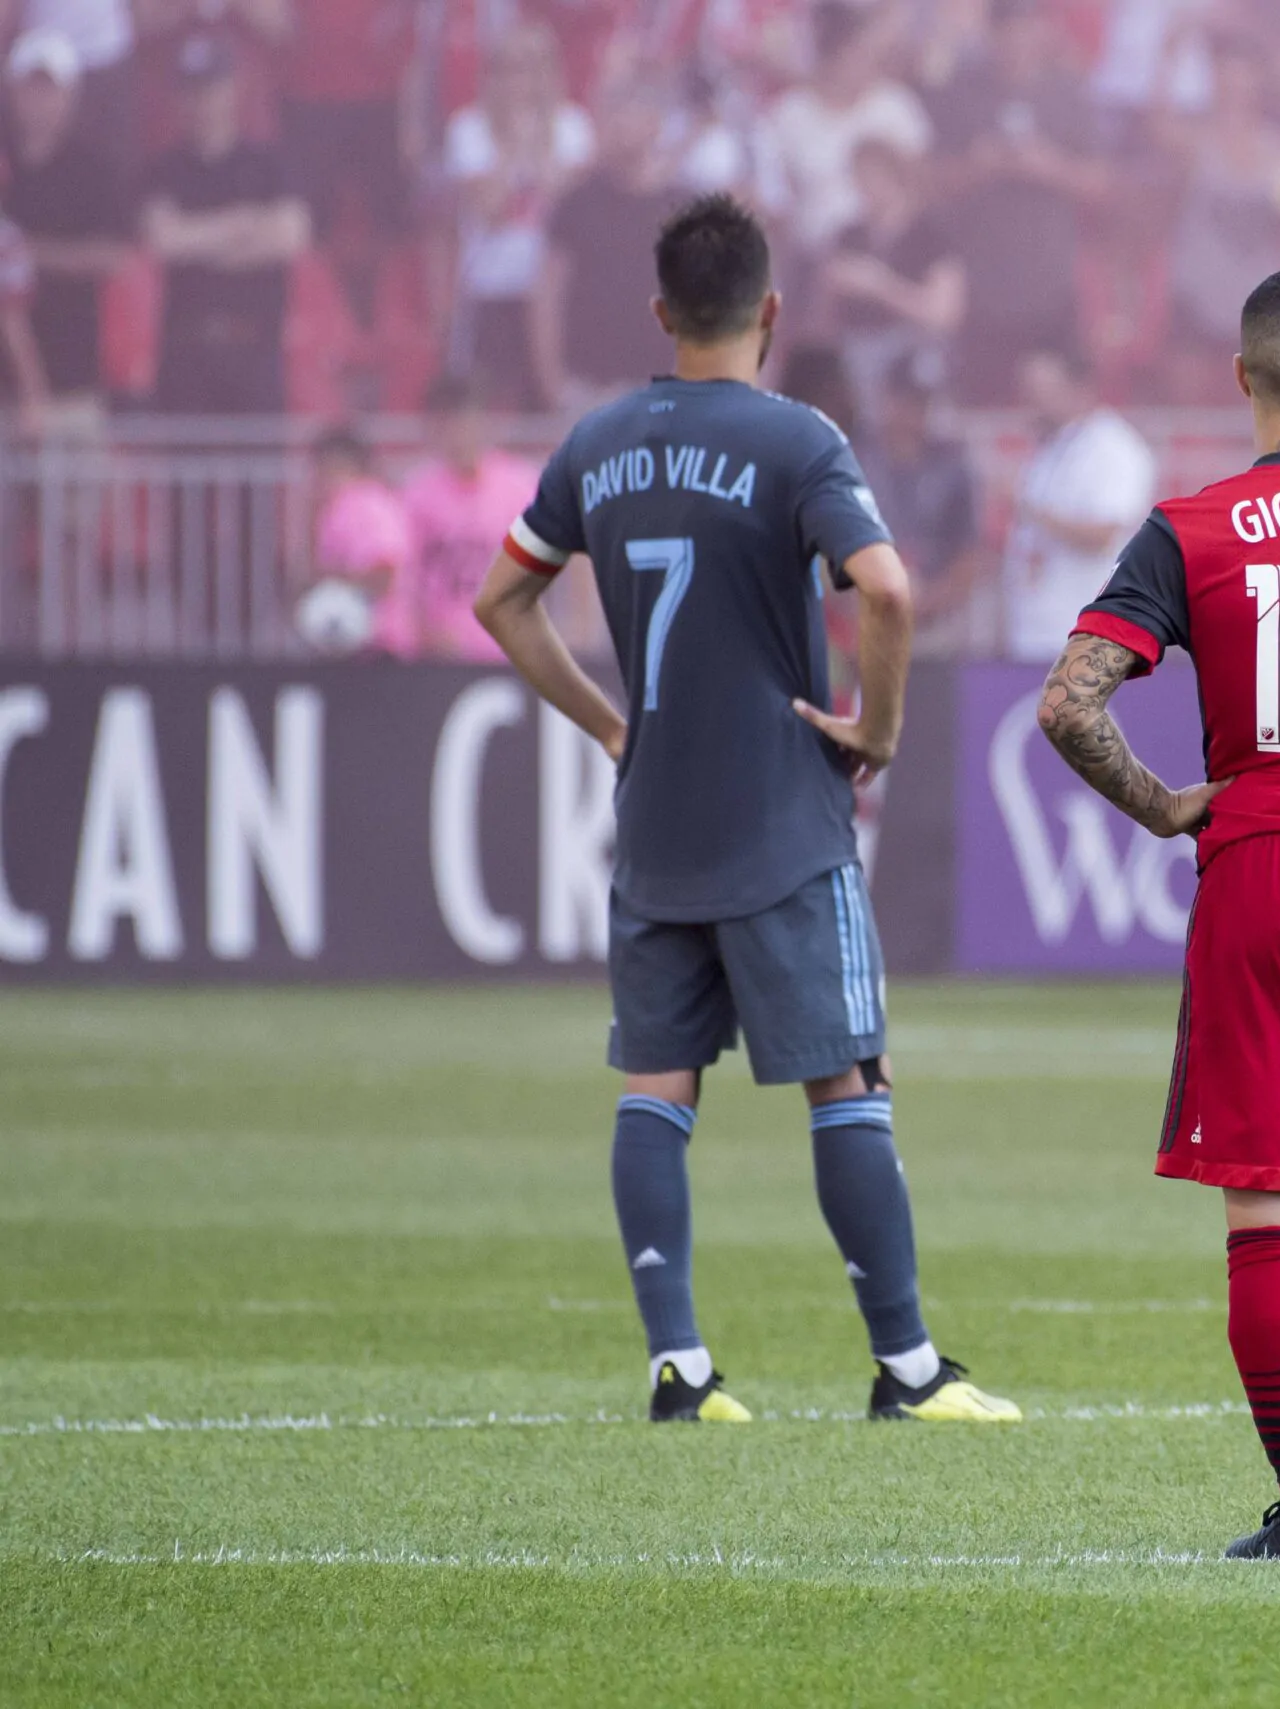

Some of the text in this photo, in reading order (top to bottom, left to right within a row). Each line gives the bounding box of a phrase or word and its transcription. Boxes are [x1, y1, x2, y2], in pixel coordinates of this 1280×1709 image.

[582, 445, 756, 514] DAVID VILLA
[625, 537, 695, 711] 7
